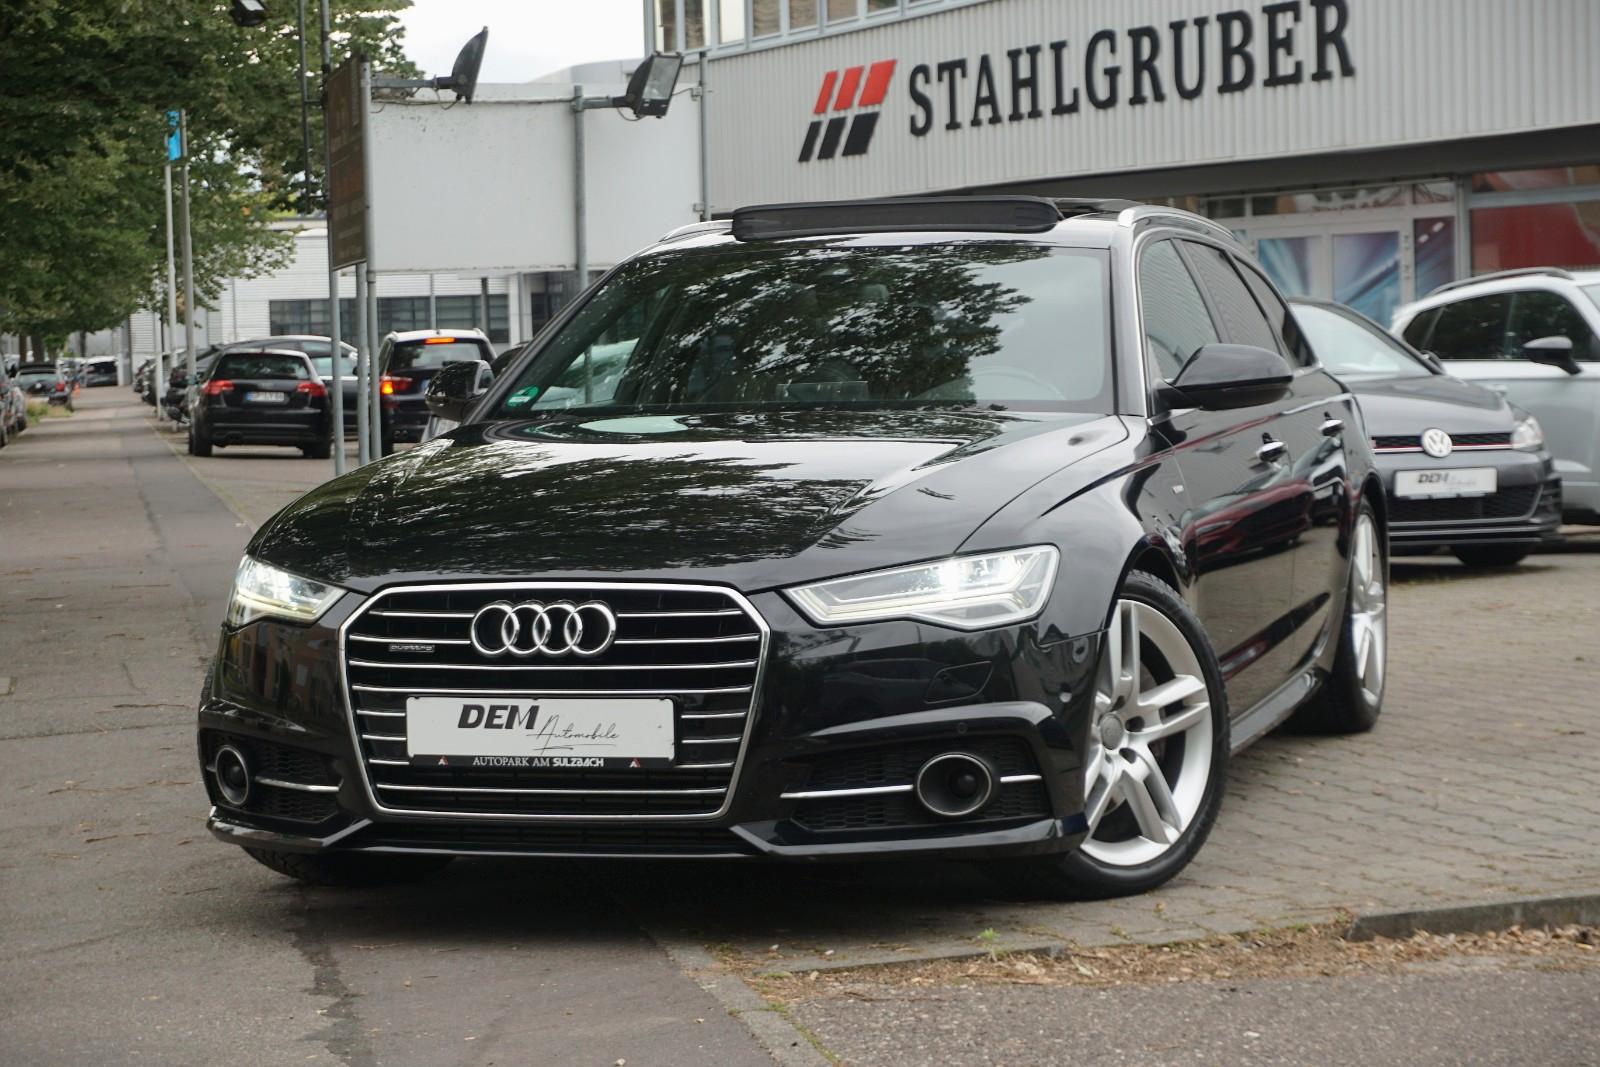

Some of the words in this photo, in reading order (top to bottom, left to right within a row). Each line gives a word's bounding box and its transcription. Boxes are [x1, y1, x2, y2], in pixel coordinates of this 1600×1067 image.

[908, 0, 1355, 137] STAHLGRUBER
[458, 704, 540, 729] DEM
[526, 714, 619, 755] Automobile
[473, 757, 529, 766] AUTOPARK
[532, 758, 550, 766] AM
